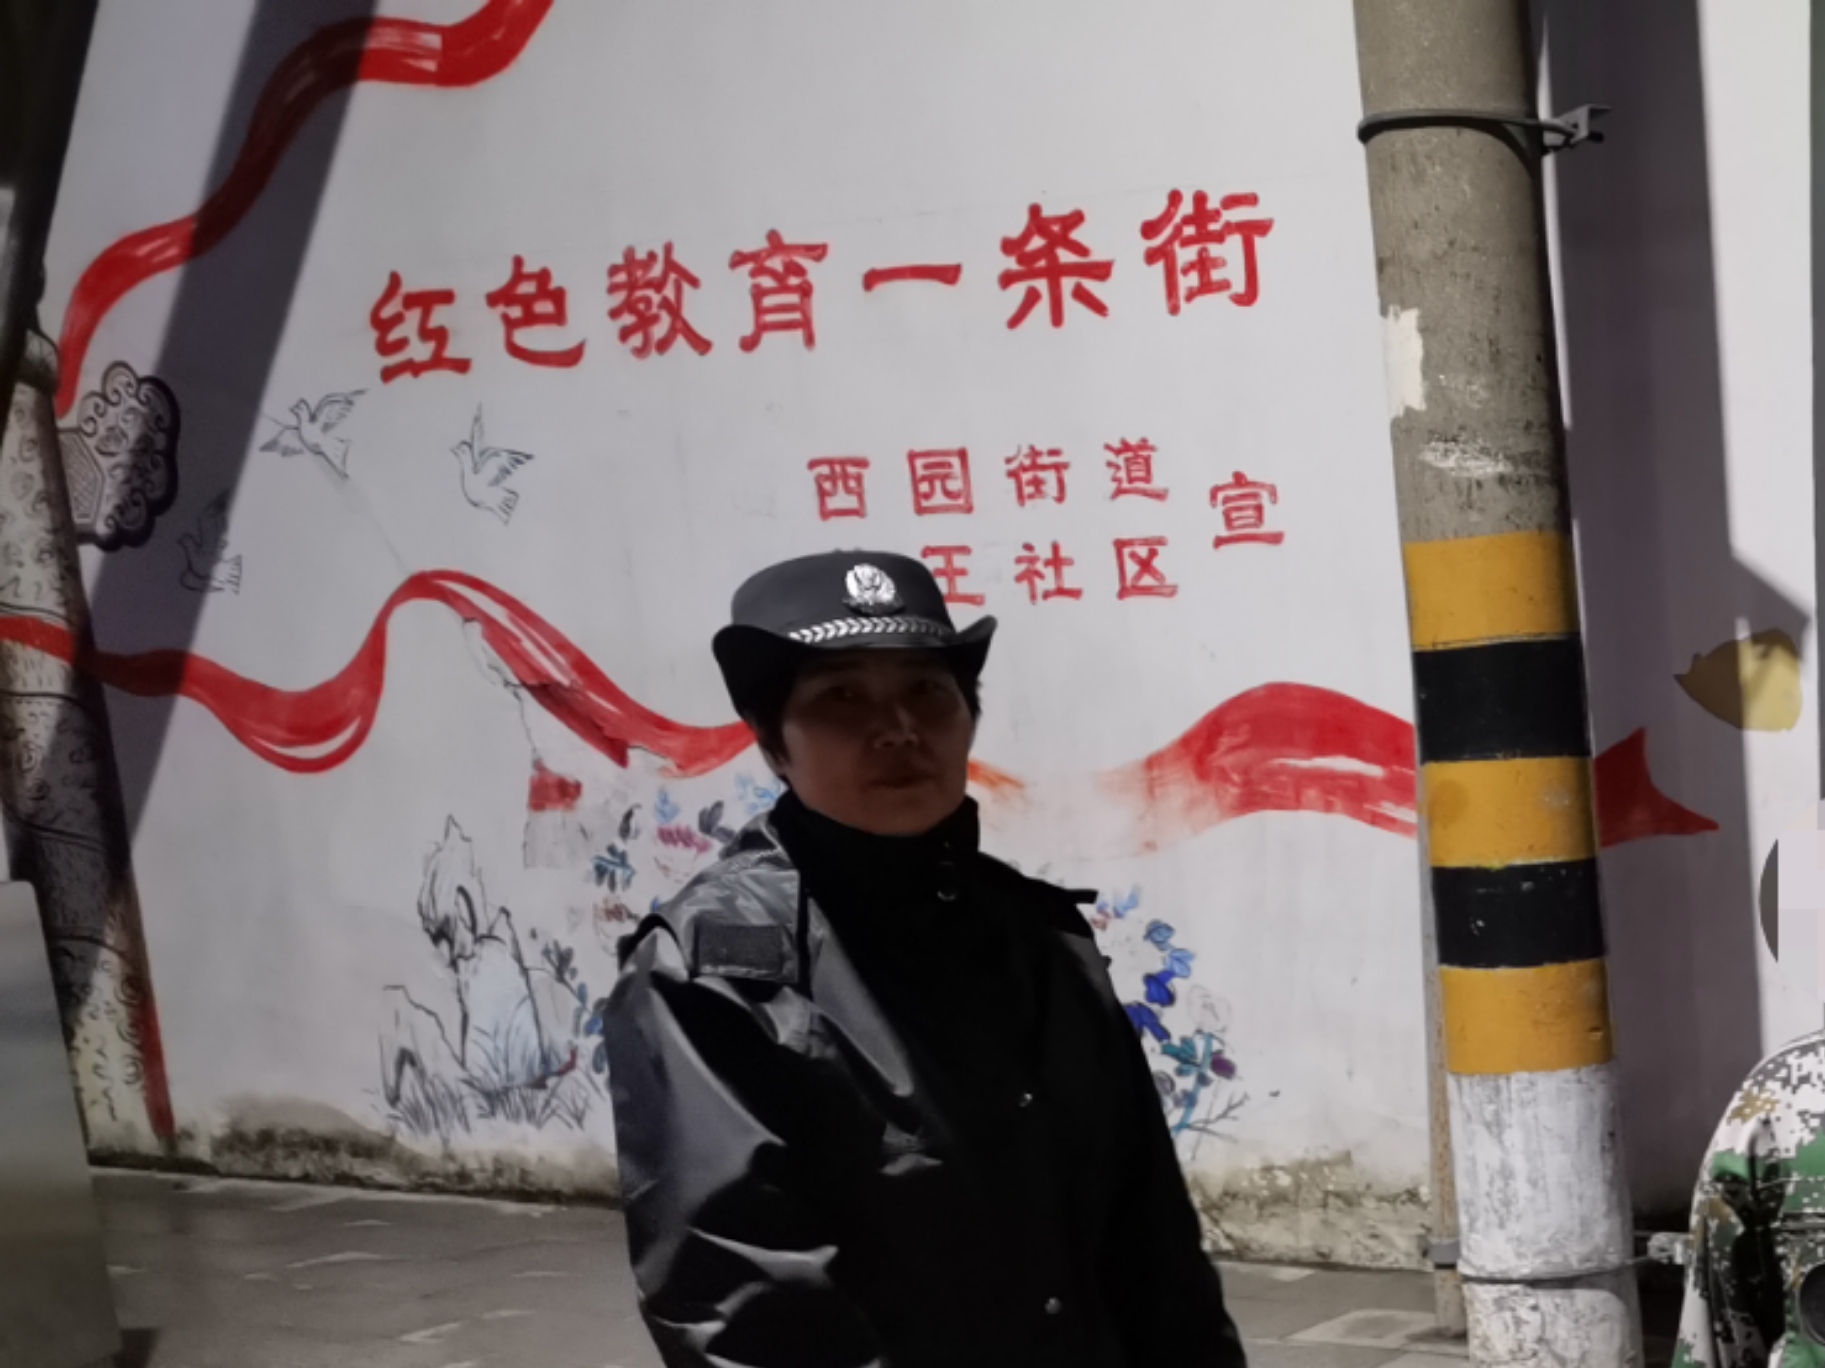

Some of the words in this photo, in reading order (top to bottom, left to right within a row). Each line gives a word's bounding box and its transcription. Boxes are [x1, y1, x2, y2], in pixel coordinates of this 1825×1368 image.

[369, 188, 1274, 384] 红色教育一条街
[807, 437, 1168, 520] 西园街道
[1209, 470, 1285, 549] 宣
